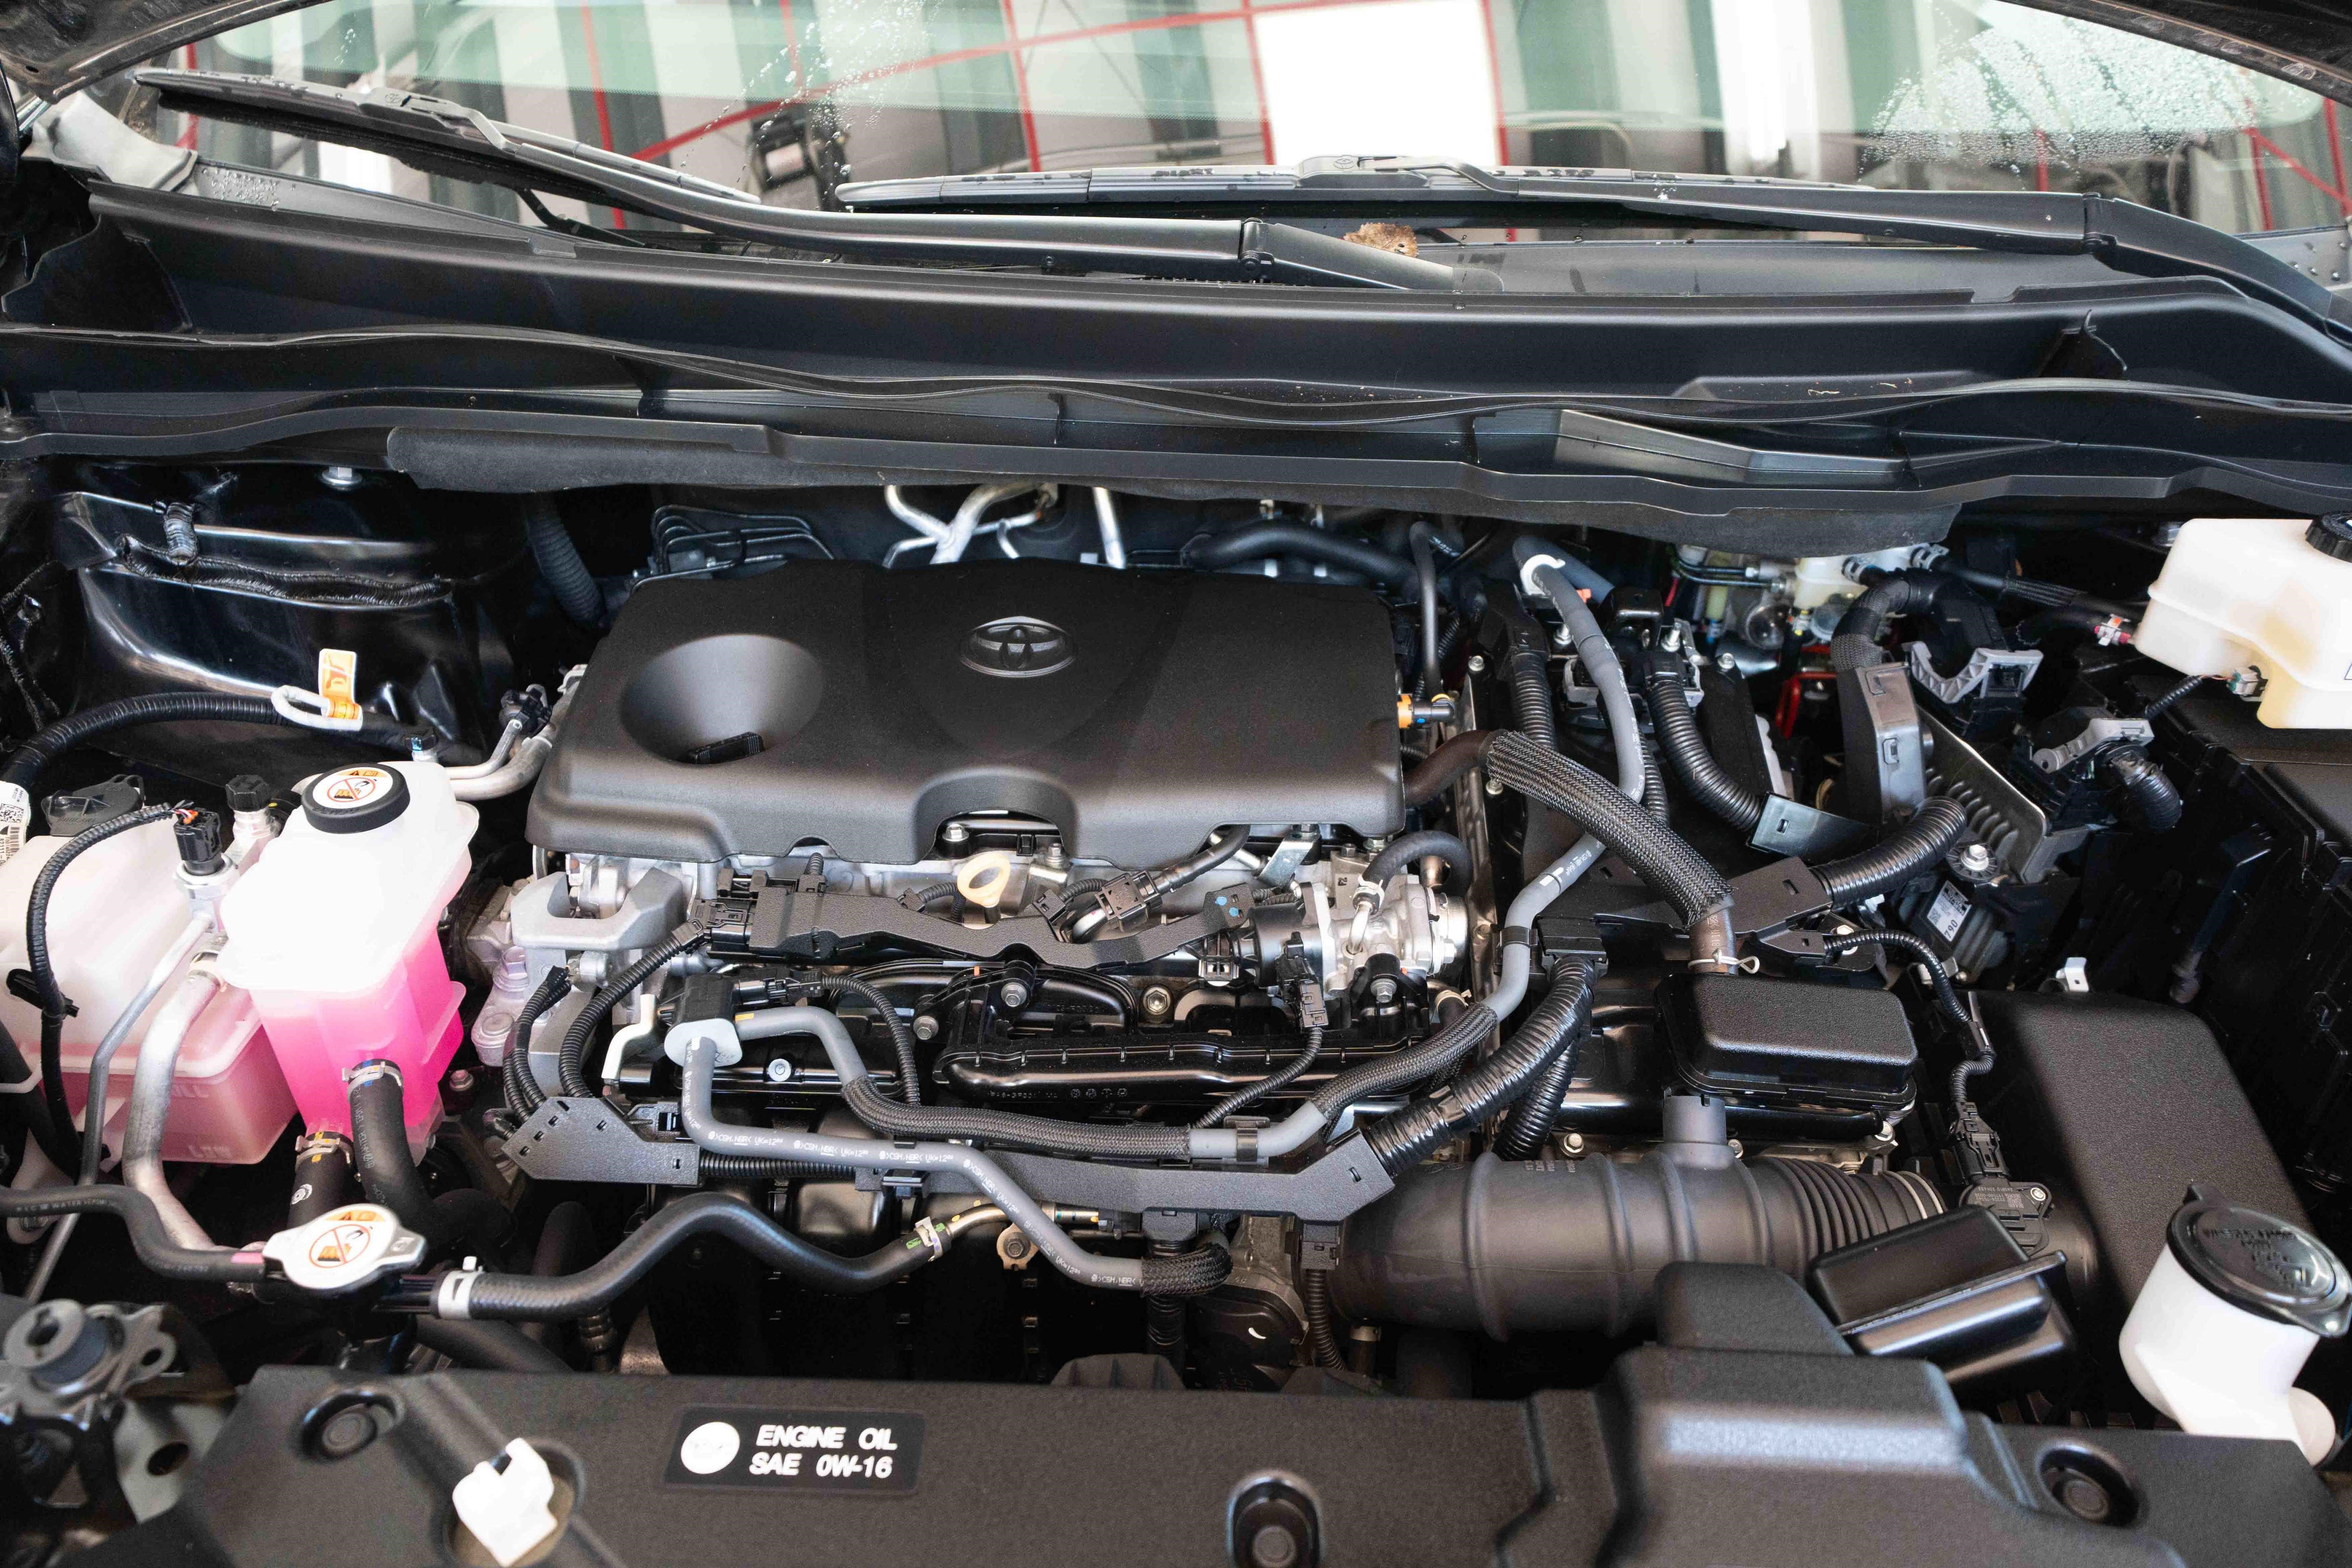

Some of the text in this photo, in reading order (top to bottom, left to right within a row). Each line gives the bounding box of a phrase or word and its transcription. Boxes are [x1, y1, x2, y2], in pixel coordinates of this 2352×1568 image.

[1944, 919, 1958, 939] 790
[755, 1424, 898, 1450] ENGINE OIL
[749, 1452, 893, 1479] SAE 0W-16
